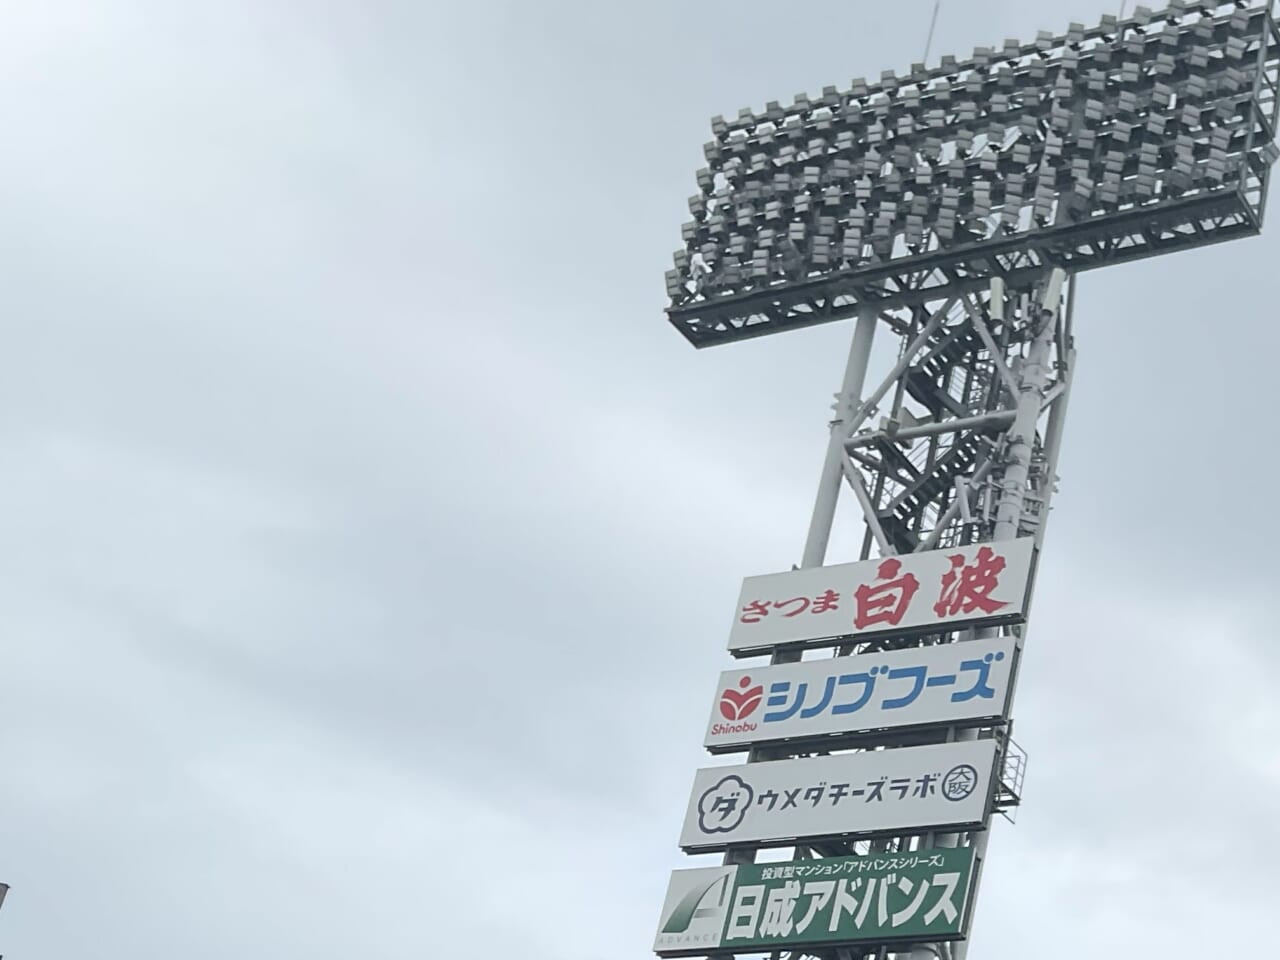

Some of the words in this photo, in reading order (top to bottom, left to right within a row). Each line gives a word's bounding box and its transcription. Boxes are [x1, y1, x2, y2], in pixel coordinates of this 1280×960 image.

[739, 590, 840, 623] さつま
[853, 546, 1014, 630] 白波
[763, 651, 1005, 723] シノブフーズ
[711, 721, 757, 736] Shinobu
[757, 772, 941, 812] ウメダチーズラボ
[947, 767, 972, 795] 大阪
[761, 855, 944, 880] 投資型マンション「アドバンスシリーズ」
[725, 871, 962, 941] 日成アドバンス
[658, 932, 718, 945] ADVANCE
